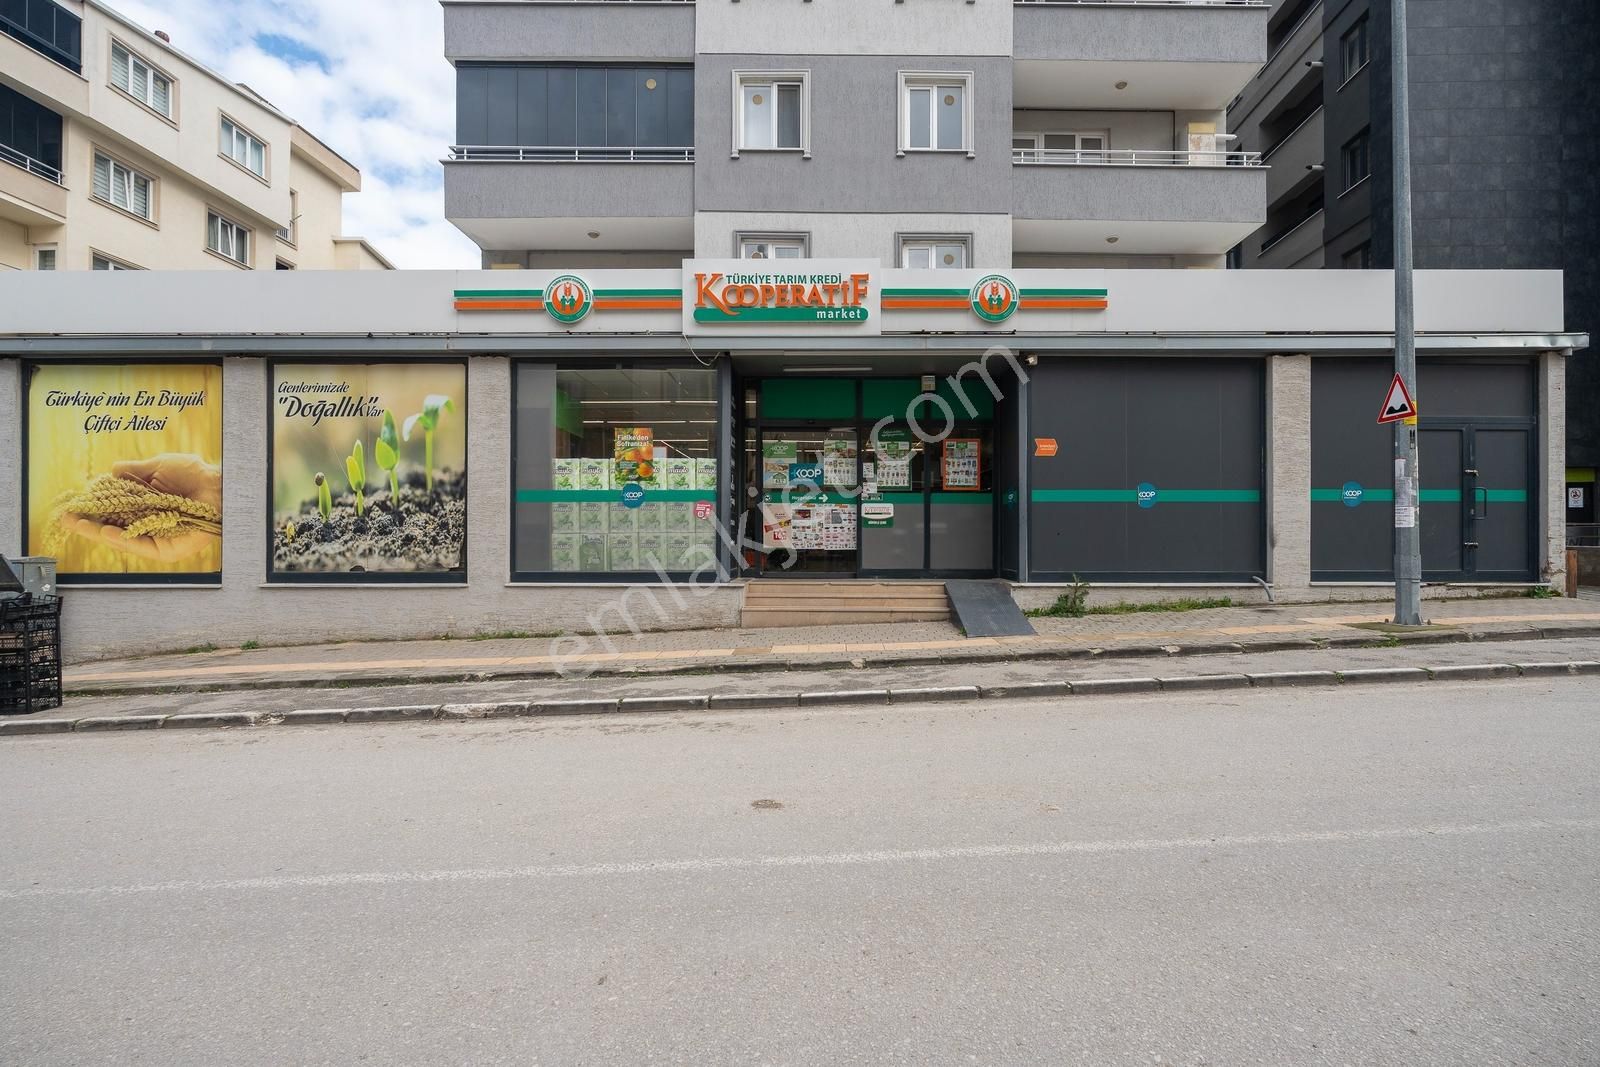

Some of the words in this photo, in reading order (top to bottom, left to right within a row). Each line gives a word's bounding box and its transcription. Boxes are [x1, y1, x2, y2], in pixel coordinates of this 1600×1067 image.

[726, 273, 771, 284] TÜRKİYE
[773, 274, 807, 284] TARIM
[810, 273, 842, 284] KREDİ
[694, 273, 870, 316] KOOPERATİF
[816, 308, 862, 319] market
[278, 381, 350, 393] Genlerimizde
[133, 390, 149, 407] En
[157, 390, 206, 412] Büyük
[366, 405, 385, 417] Var
[84, 414, 121, 434] Çiftçi
[123, 413, 168, 431] Ailesi
[795, 468, 821, 478] KOOP
